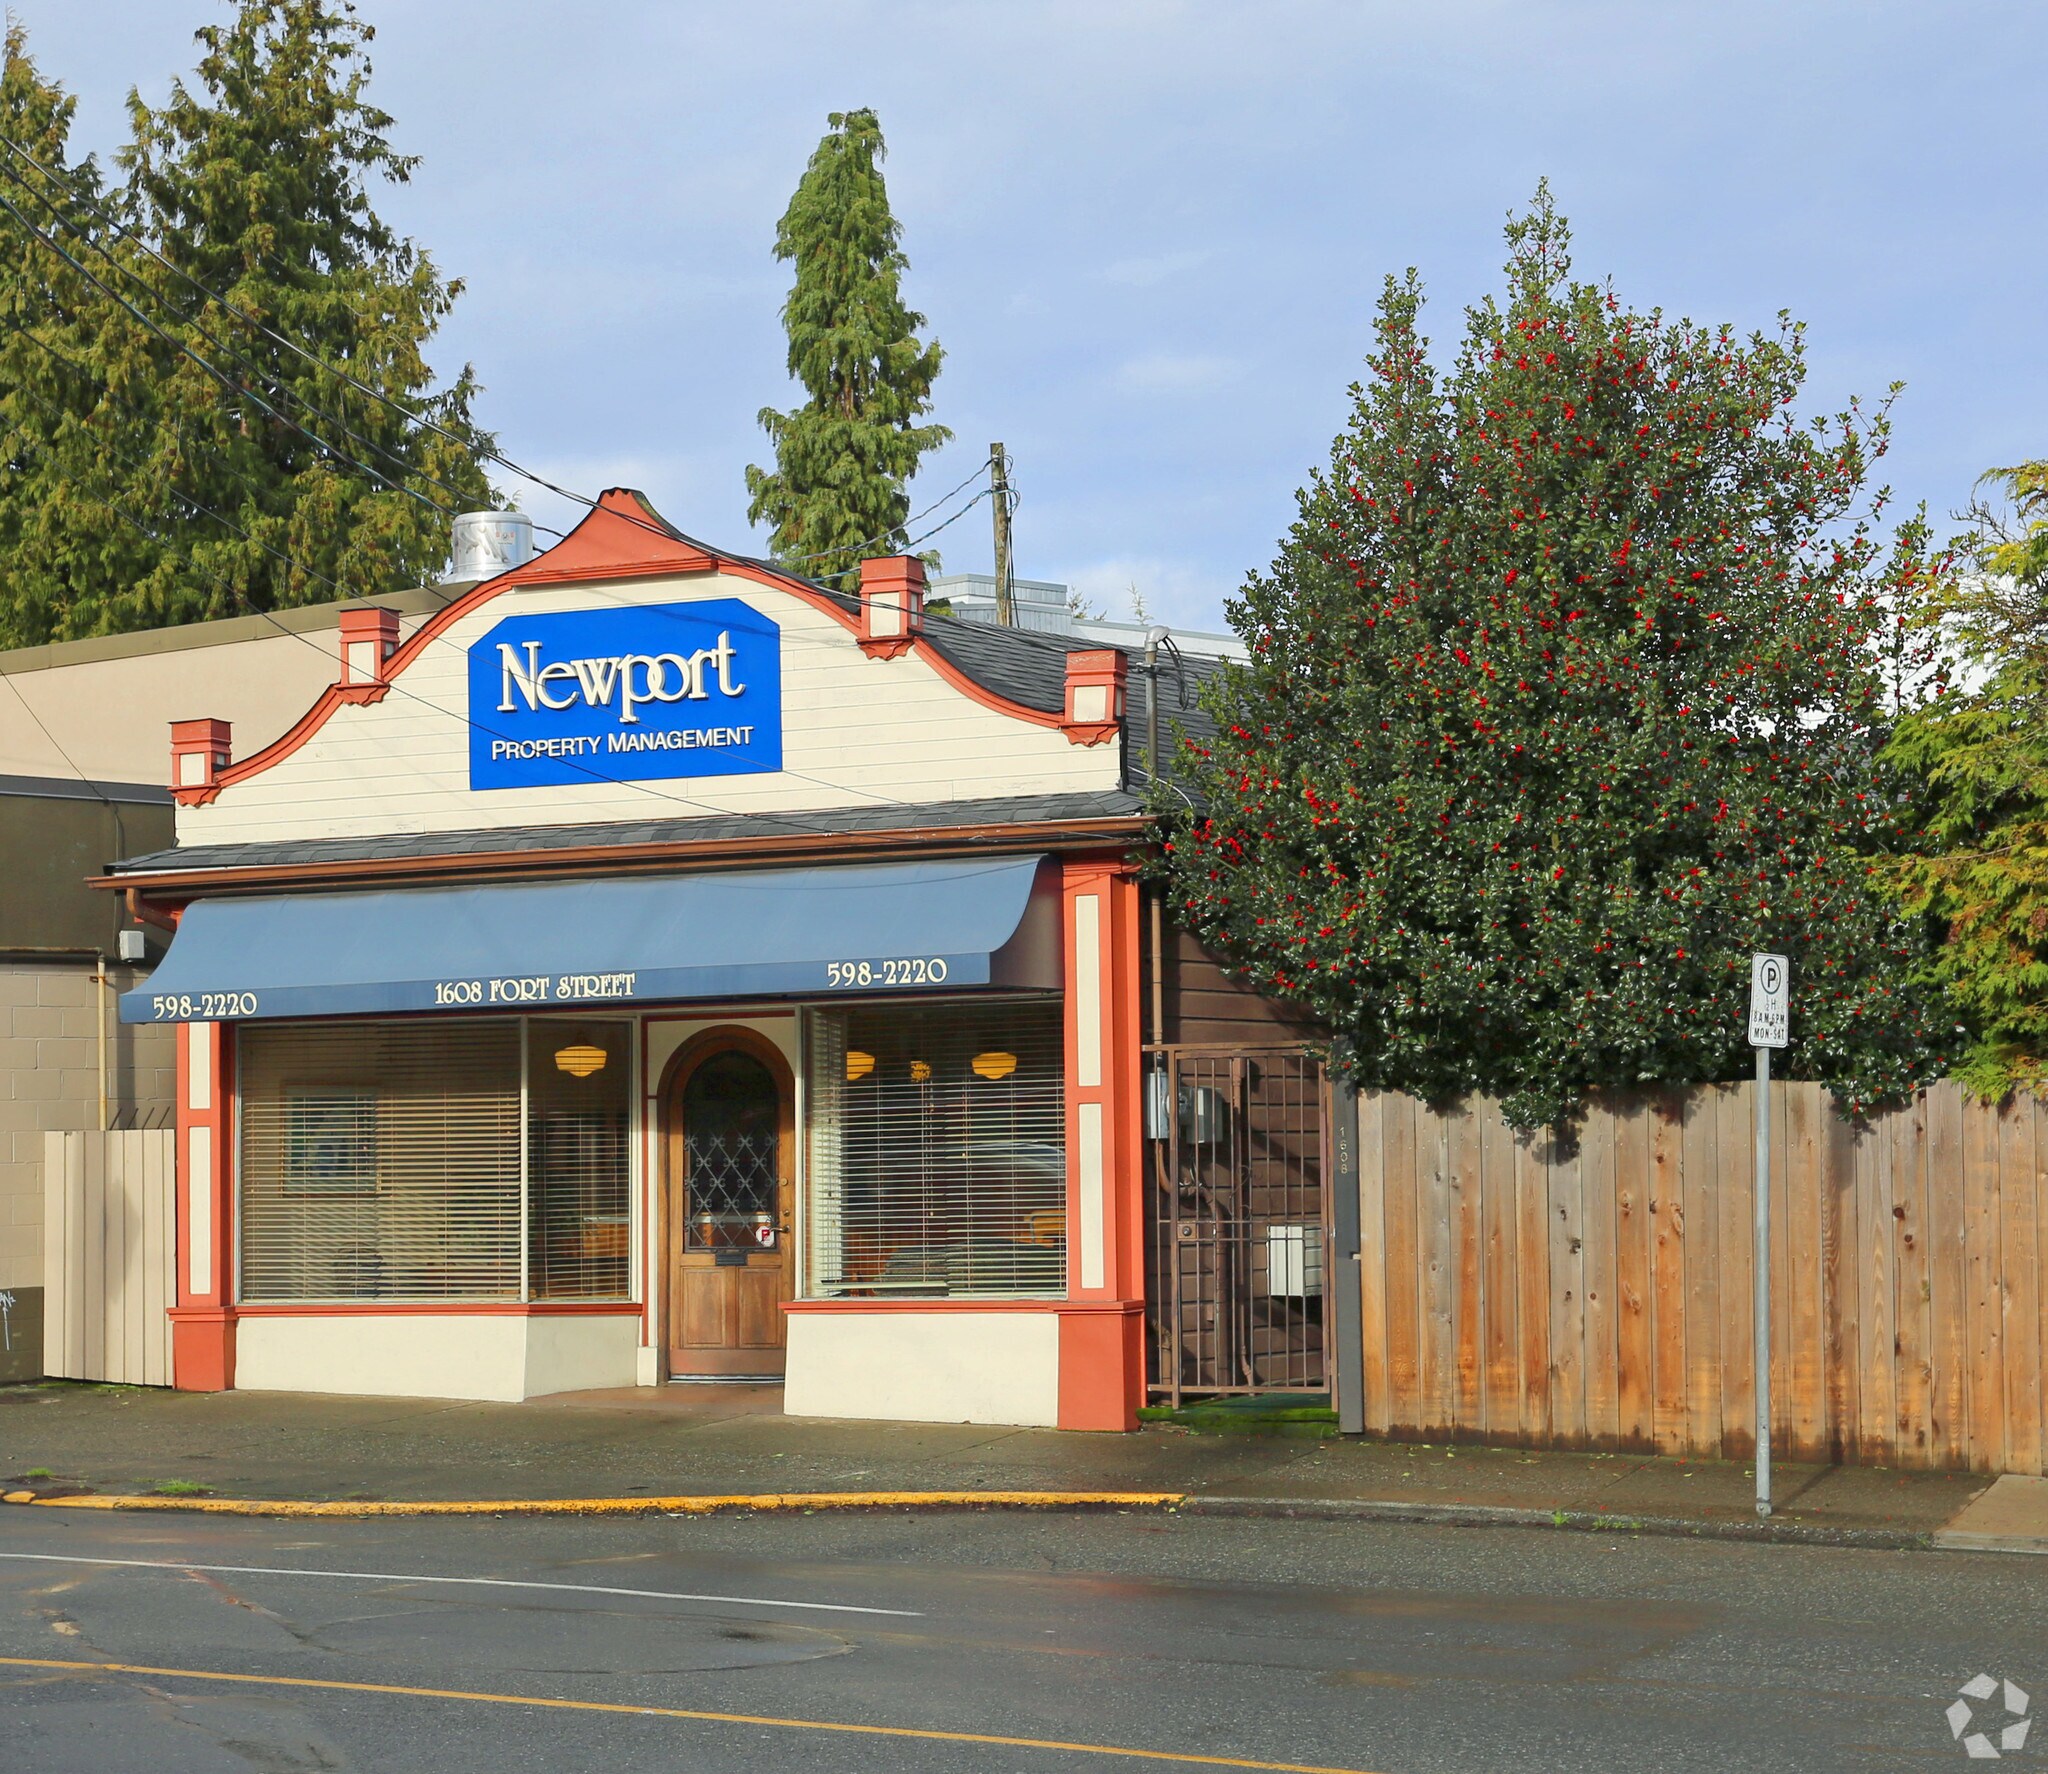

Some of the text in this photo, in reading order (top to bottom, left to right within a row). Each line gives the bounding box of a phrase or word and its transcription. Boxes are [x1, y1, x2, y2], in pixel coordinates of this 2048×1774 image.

[496, 630, 746, 723] Newport
[491, 726, 755, 761] PROPERTY MANAGEMENT
[827, 958, 948, 987] 598-2220
[1767, 967, 1777, 988] P
[434, 972, 636, 1005] 1608 FORT STREET
[153, 992, 258, 1020] 598-2220
[1753, 1027, 1785, 1040] MON-SAT
